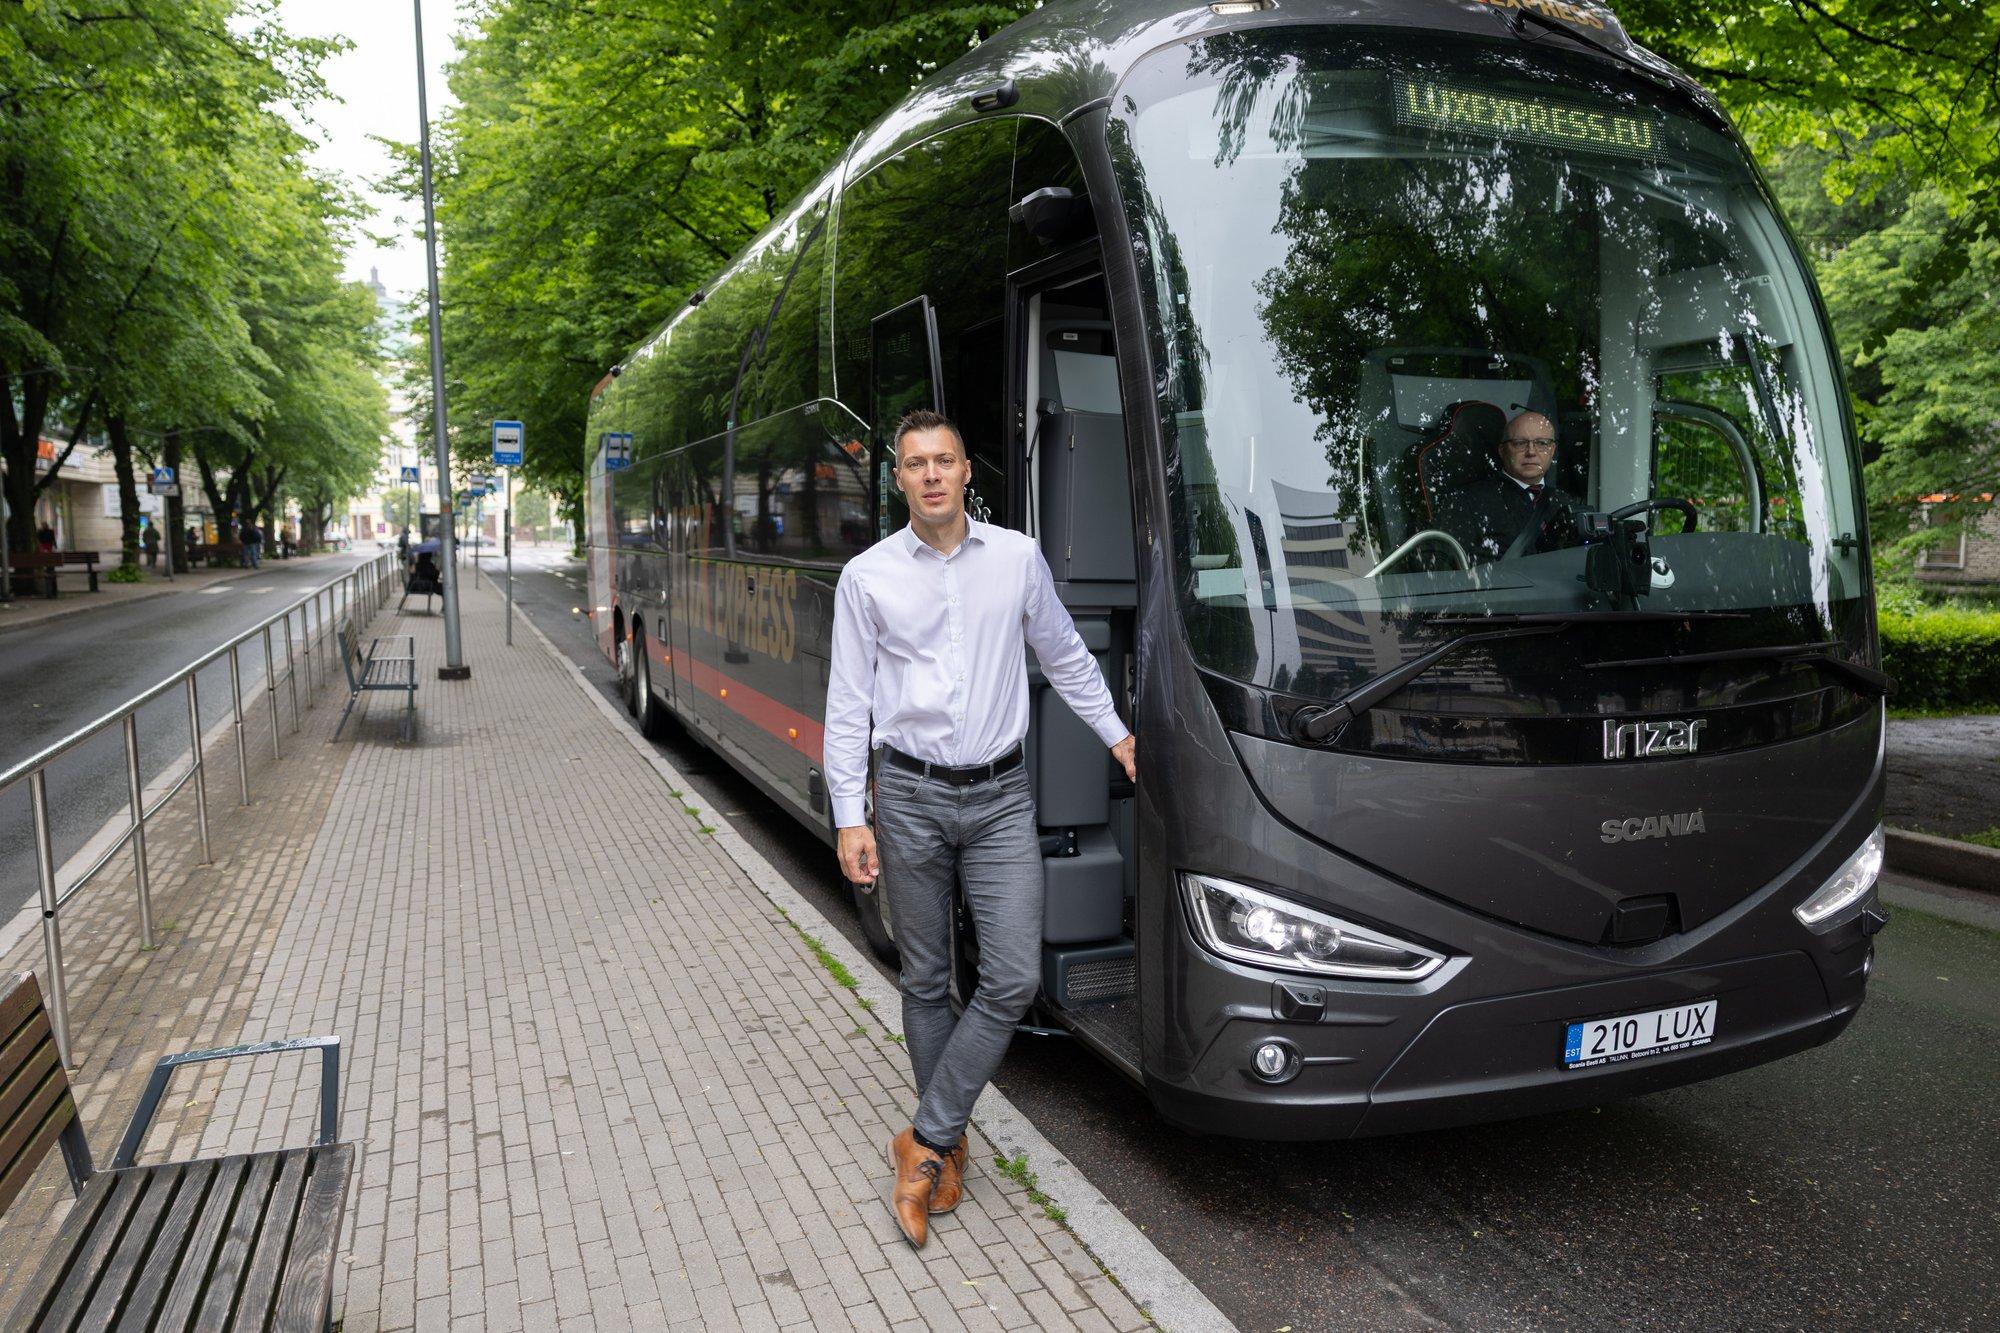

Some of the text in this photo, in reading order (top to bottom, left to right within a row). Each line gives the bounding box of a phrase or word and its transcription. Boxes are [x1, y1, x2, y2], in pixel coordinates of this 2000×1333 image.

[1408, 84, 1653, 149] LUXEXPRESS.EU
[715, 562, 797, 664] EXPRESS
[1600, 810, 1706, 843] SCANIA
[1565, 1047, 1580, 1057] EST
[1591, 1005, 1709, 1055] 210 LUX
